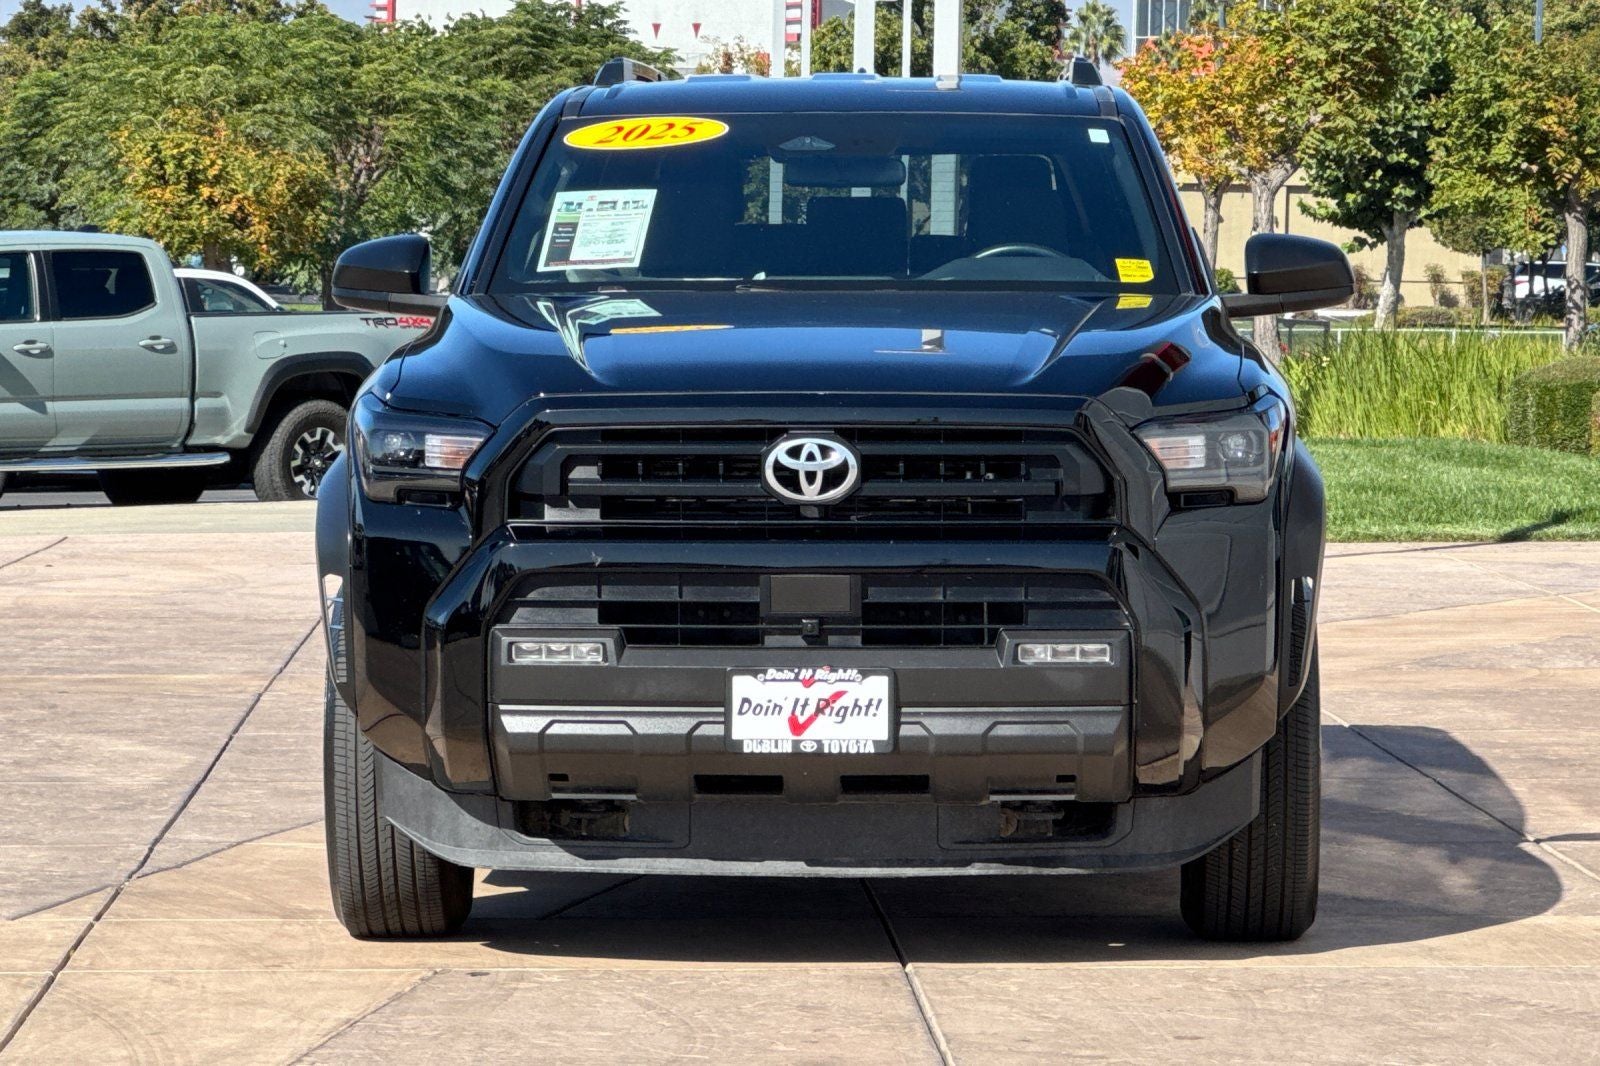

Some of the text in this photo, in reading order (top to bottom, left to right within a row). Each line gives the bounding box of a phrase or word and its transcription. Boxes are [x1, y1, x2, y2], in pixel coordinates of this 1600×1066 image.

[594, 123, 703, 144] 2025
[765, 668, 857, 684] Doin' It Right!
[737, 697, 883, 724] Doin' It Right!
[743, 739, 875, 753] DUBLIN TOYOTA
